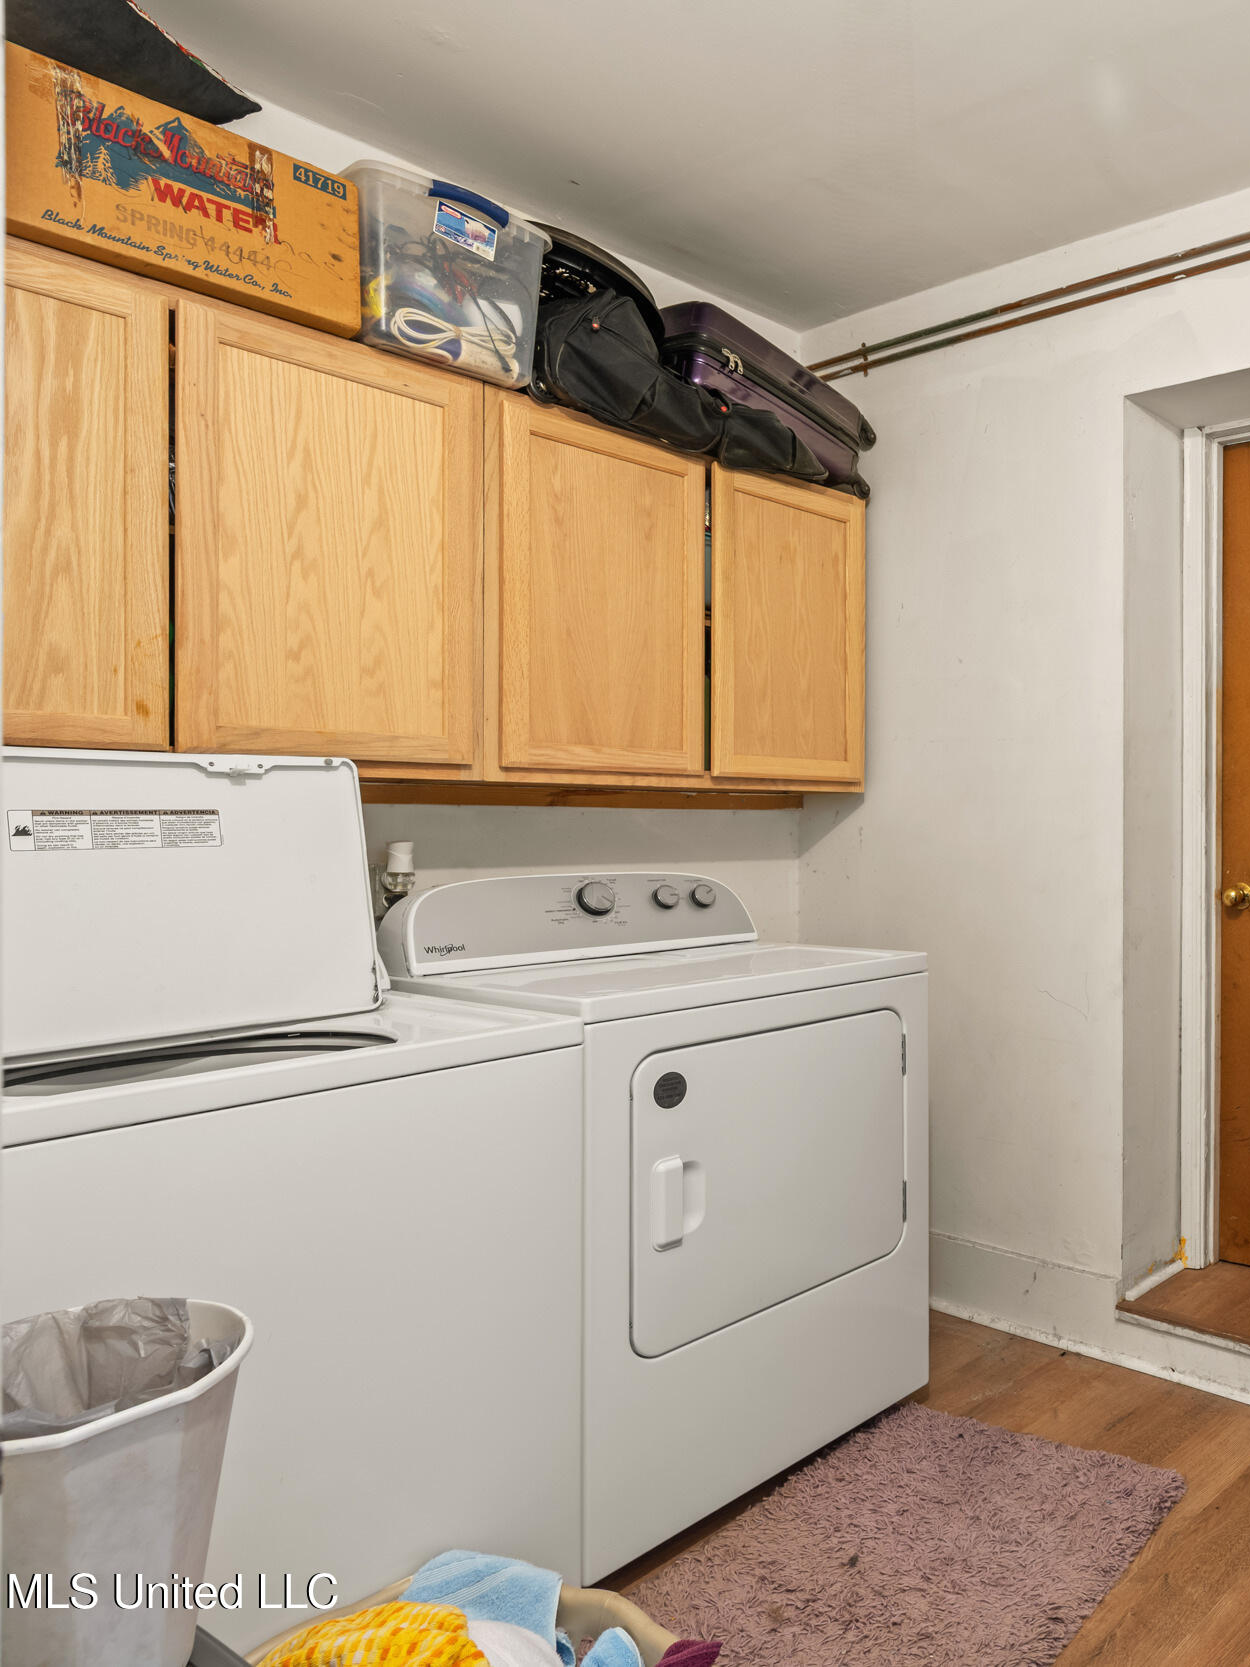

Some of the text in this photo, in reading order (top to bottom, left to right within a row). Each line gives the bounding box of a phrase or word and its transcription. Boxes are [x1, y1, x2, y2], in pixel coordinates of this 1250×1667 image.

[295, 167, 344, 197] 41719
[115, 202, 199, 248] SPRING
[151, 177, 282, 245] WATER
[41, 208, 85, 231] Black
[86, 223, 153, 253] Mountain
[202, 259, 243, 281] Water
[269, 282, 293, 299] Inc.
[423, 943, 466, 957] Whirlpool
